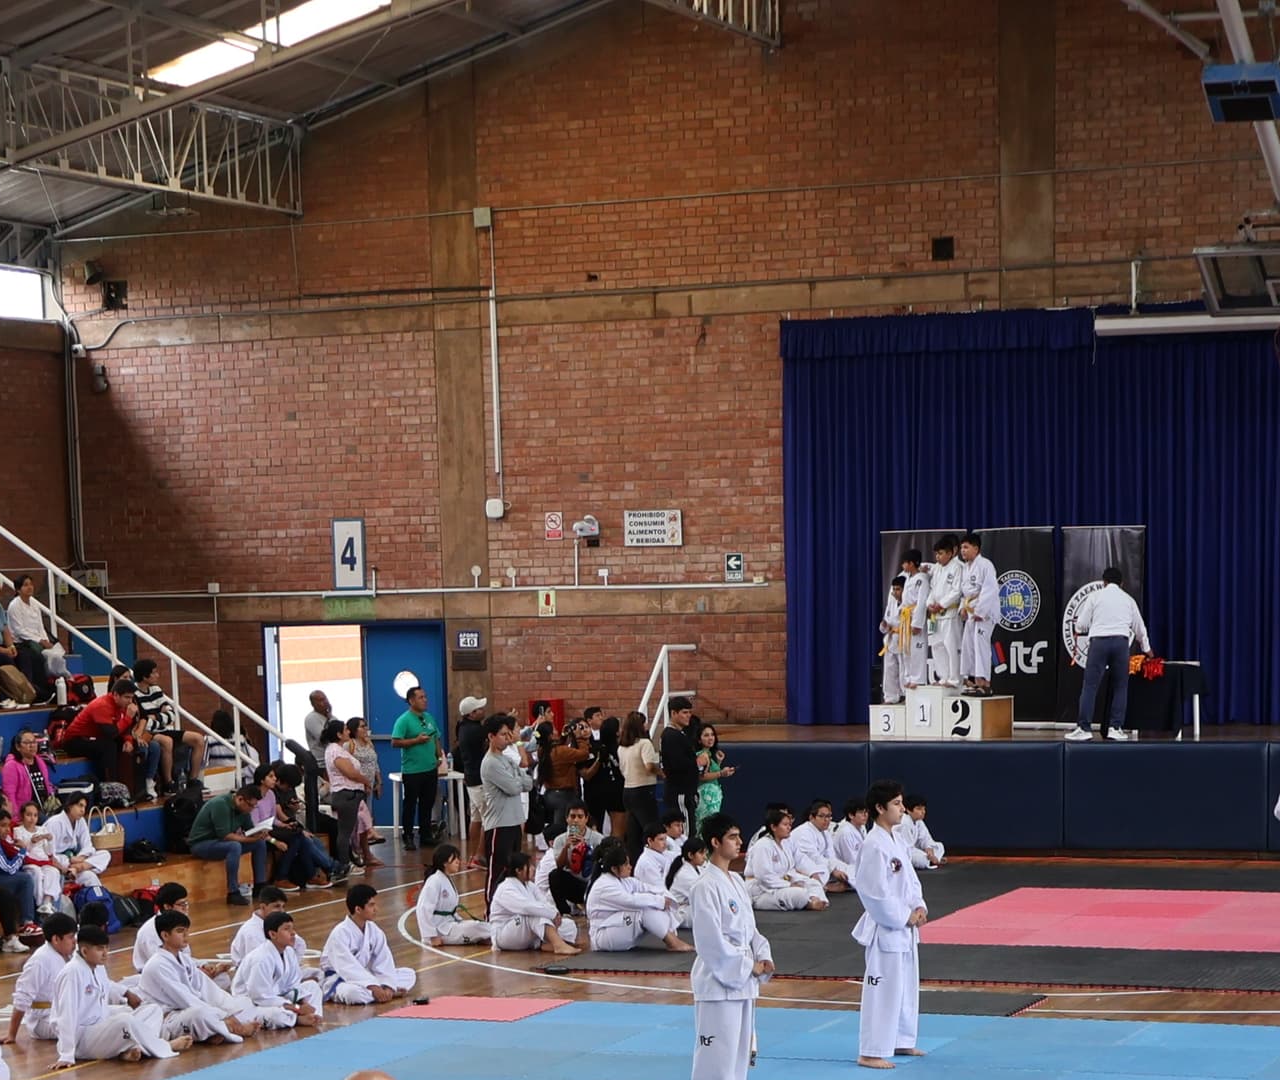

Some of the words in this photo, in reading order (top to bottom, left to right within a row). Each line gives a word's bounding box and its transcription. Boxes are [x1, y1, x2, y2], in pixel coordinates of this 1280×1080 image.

[341, 536, 357, 571] 4
[882, 713, 892, 732] 3
[919, 704, 928, 723] 1
[951, 699, 971, 737] 2
